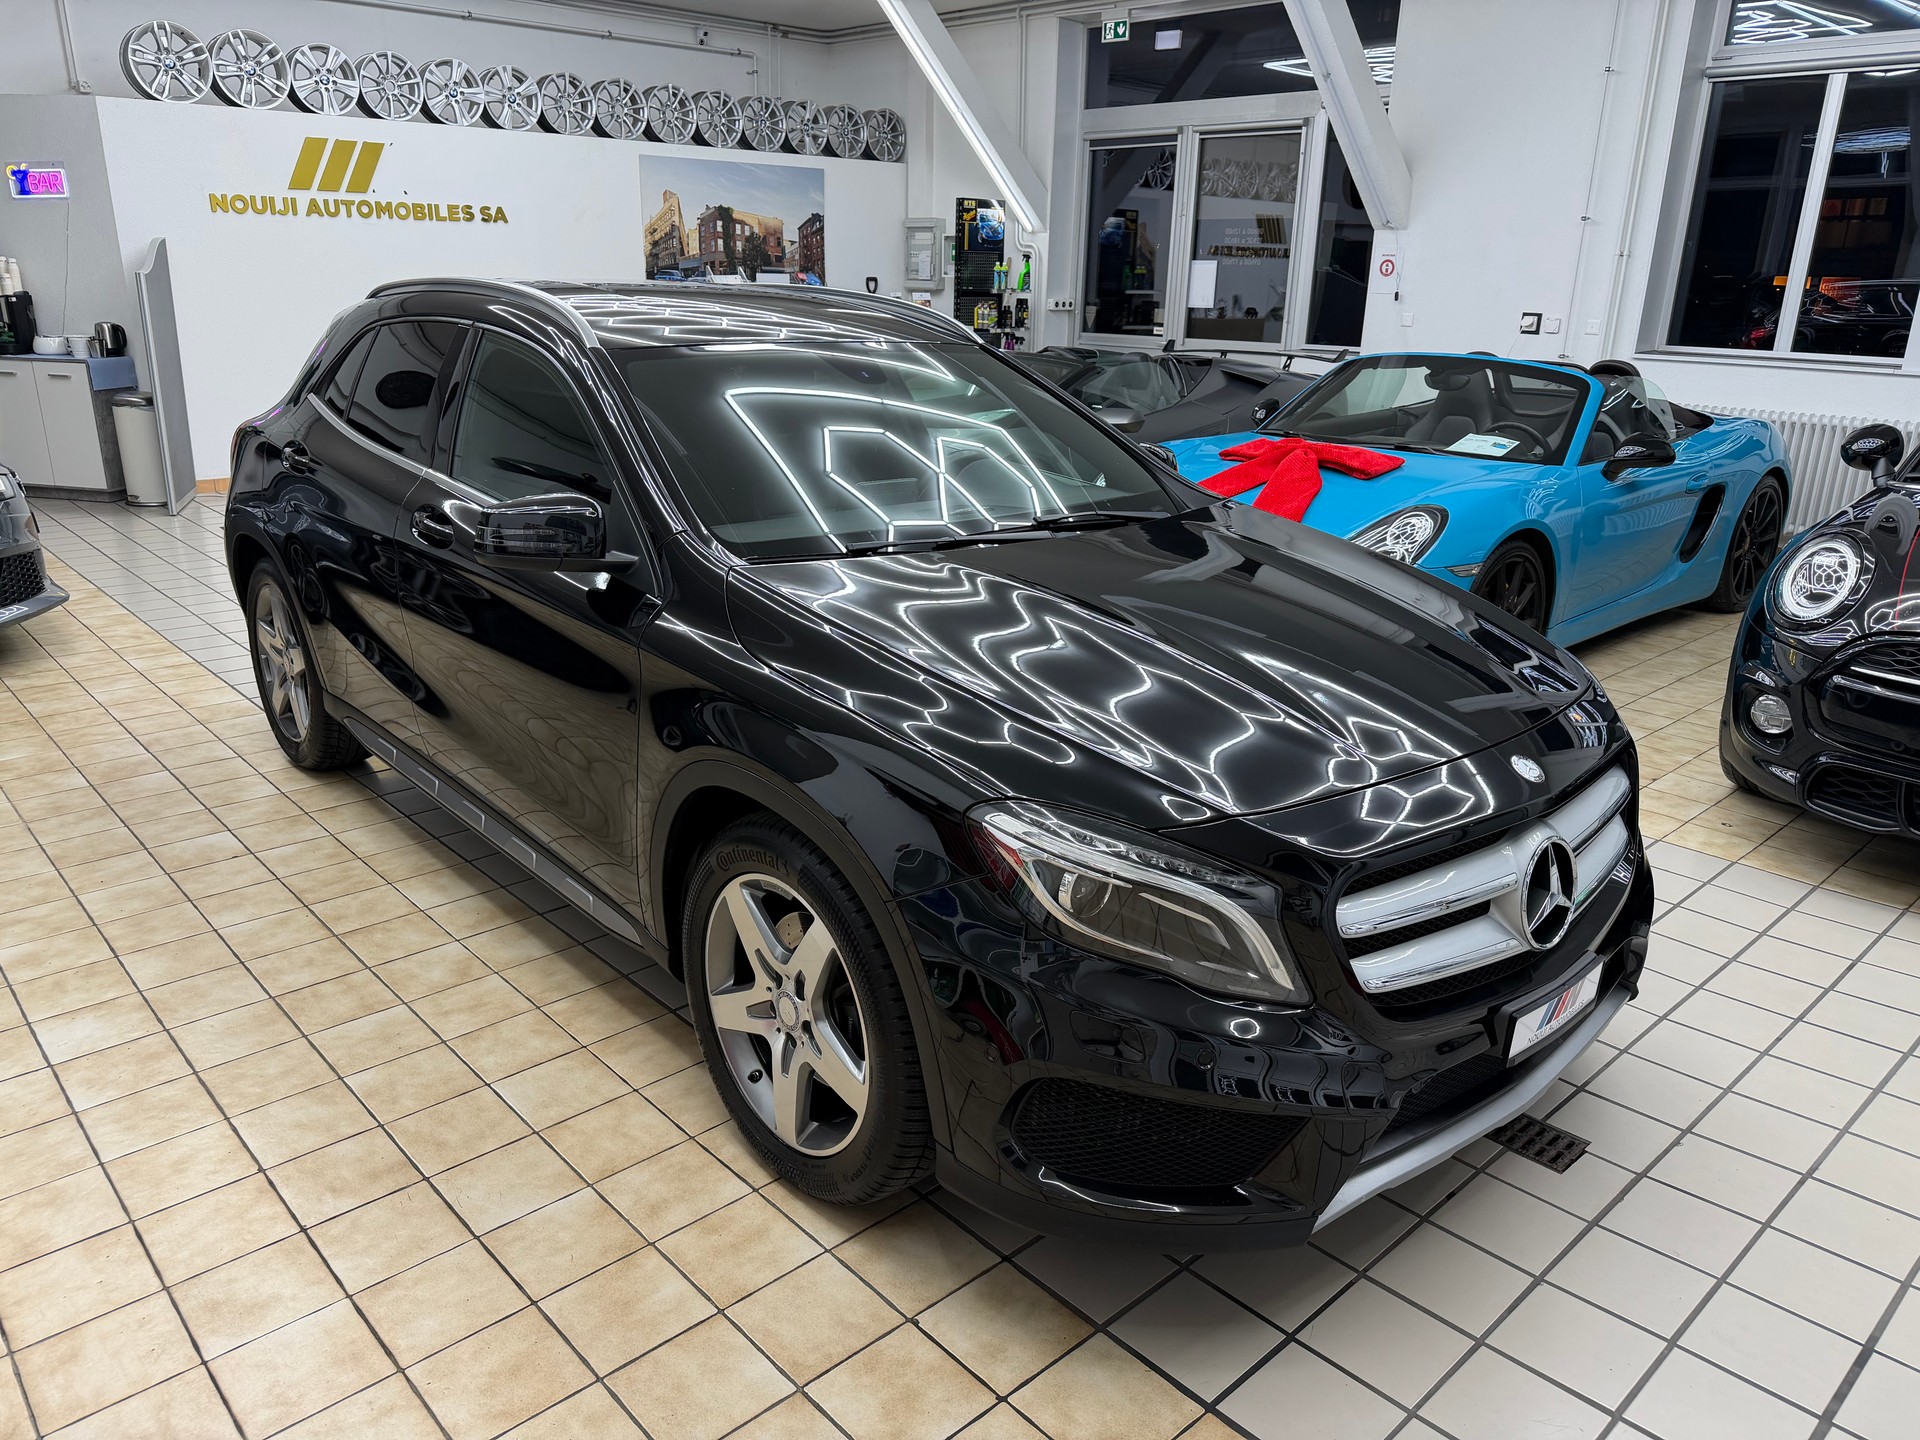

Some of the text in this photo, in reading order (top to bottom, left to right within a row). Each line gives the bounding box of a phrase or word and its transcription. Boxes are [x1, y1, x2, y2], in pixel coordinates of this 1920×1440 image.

[27, 172, 64, 193] BAR
[209, 193, 509, 224] NOUIJI AUTOMOBILES SA
[716, 845, 781, 872] Continental
